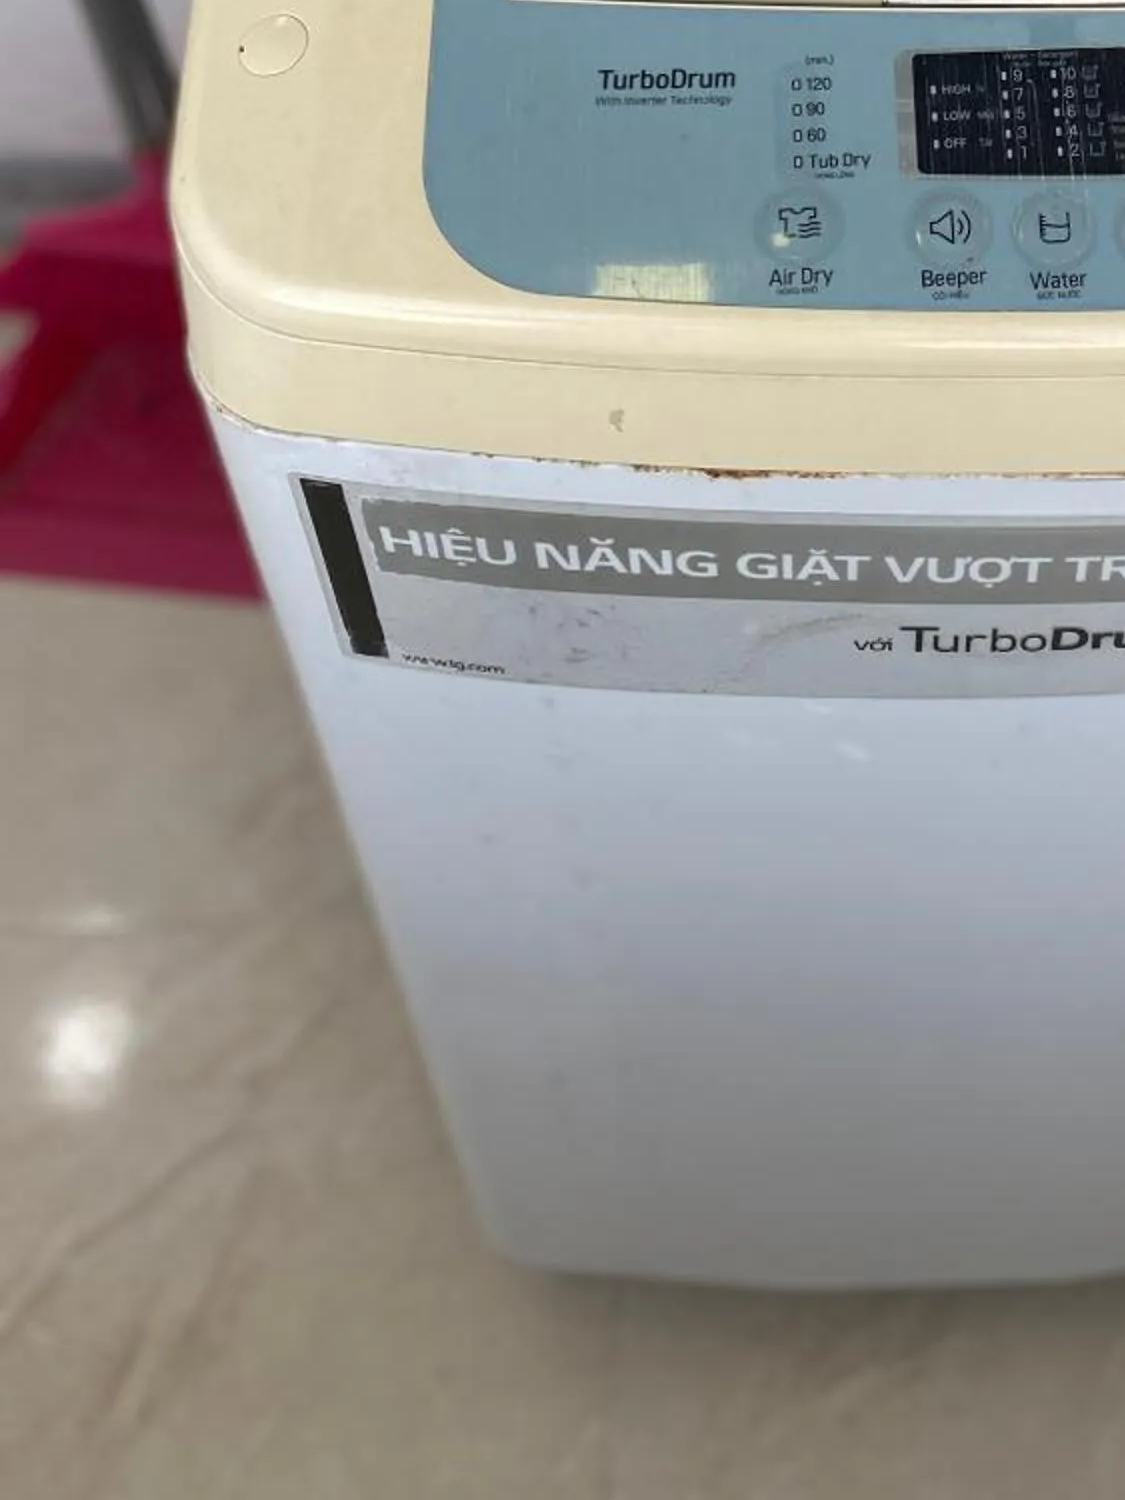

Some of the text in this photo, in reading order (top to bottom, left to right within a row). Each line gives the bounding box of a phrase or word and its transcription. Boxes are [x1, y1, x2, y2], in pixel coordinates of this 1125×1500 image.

[598, 68, 736, 90] TurboDrum
[1013, 69, 1023, 81] 9
[806, 77, 832, 91] 120
[941, 83, 971, 95] HIGH
[1014, 87, 1024, 100] 7
[806, 101, 825, 116] 90
[943, 110, 971, 121] LOW
[1016, 107, 1026, 119] 5
[1068, 104, 1077, 118] 6
[807, 127, 826, 143] 60
[1016, 125, 1027, 139] 3
[943, 137, 967, 149] OFF
[809, 152, 871, 170] Tub Dry
[769, 267, 834, 288] Air Dry
[921, 269, 988, 288] Beeper
[1030, 271, 1087, 290] Water
[379, 526, 518, 568] HIỆU
[534, 538, 719, 579] NĂNG
[735, 548, 872, 587] GIẶT
[884, 555, 1054, 589] VƯỢT
[853, 635, 895, 652] với
